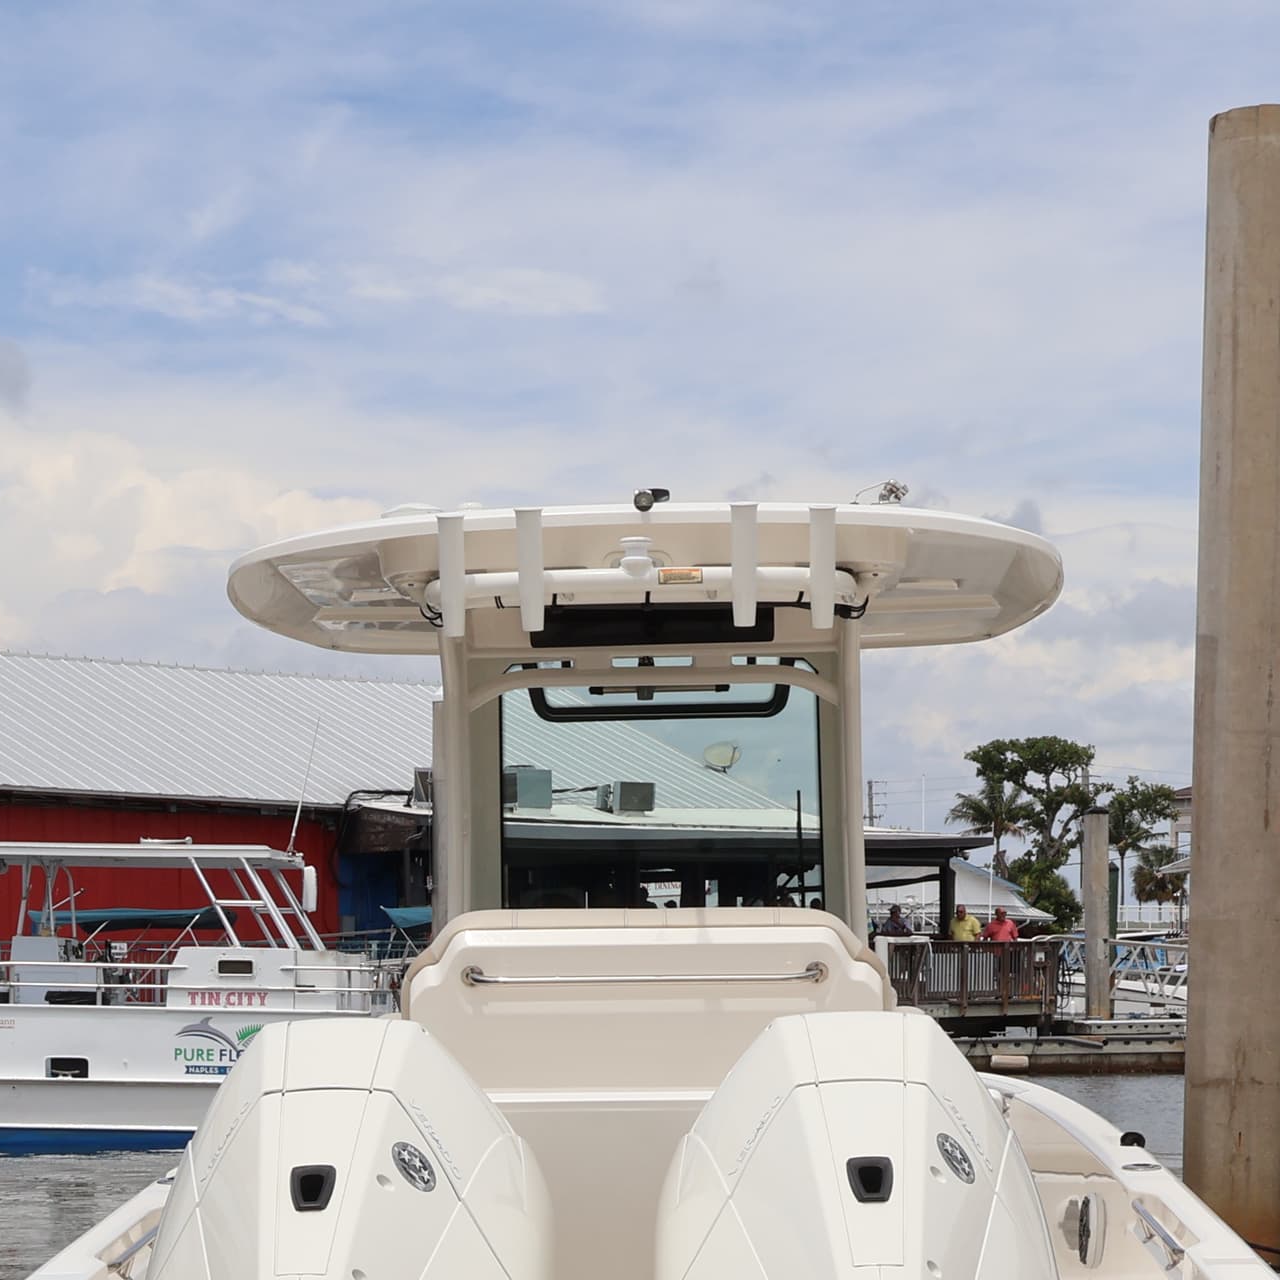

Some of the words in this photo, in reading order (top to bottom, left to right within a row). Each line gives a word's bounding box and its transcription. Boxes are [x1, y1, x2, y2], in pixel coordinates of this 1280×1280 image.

[187, 991, 221, 1006] TIN
[225, 991, 269, 1006] CITY
[174, 1047, 215, 1062] PURE
[188, 1065, 219, 1074] NAPLES
